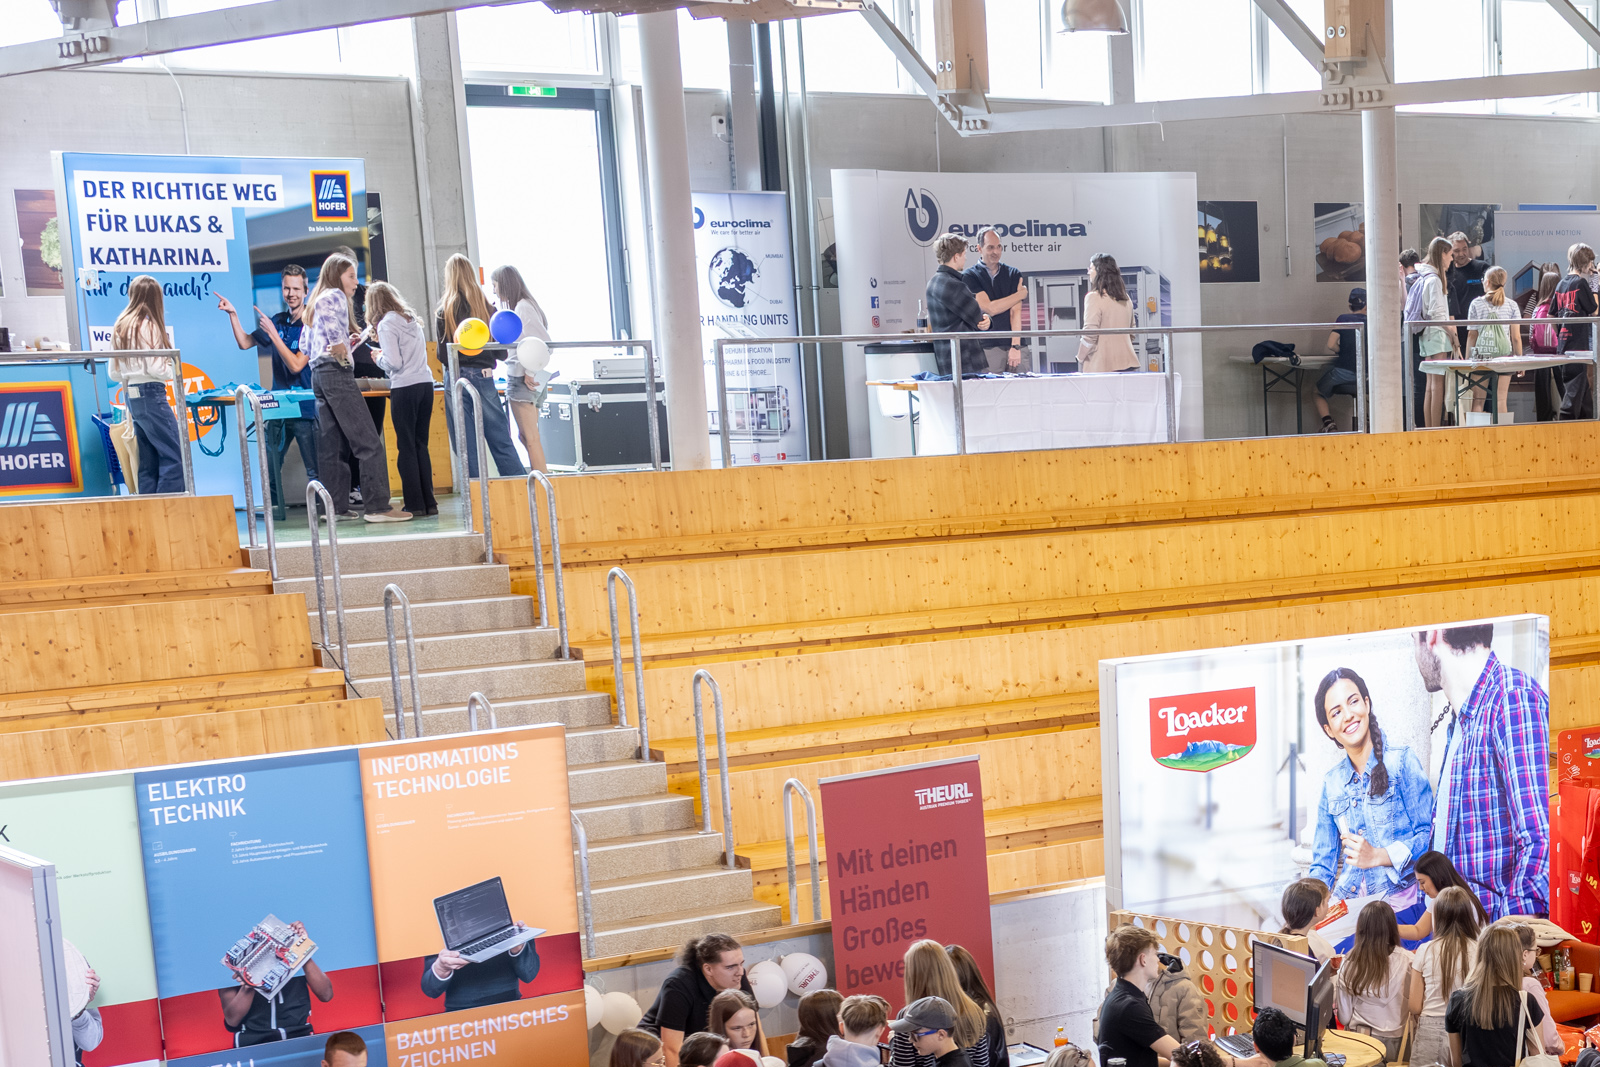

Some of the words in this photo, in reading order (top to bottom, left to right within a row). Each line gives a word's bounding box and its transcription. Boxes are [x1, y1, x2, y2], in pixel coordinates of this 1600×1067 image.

[83, 180, 125, 199] DER
[131, 181, 228, 201] RICHTIGE
[233, 183, 277, 201] WEG
[86, 208, 128, 233] FÜR
[135, 215, 201, 233] LUKAS
[208, 215, 223, 233] &
[318, 201, 347, 211] HOFER
[710, 219, 771, 228] euroclima
[89, 247, 222, 266] KATHARINA.
[1011, 242, 1044, 253] better
[1047, 242, 1062, 253] air
[760, 314, 788, 325] UNITS
[0, 453, 66, 470] HOFER
[1158, 702, 1248, 738] Loacker
[370, 742, 519, 776] INFORMATIONS
[146, 773, 247, 803] ELEKTRO
[372, 765, 511, 800] TECHNOLOGIE
[914, 782, 973, 805] THEURL
[150, 797, 247, 827] TECHNIK
[837, 849, 873, 878] Mit
[880, 838, 957, 870] deinen
[840, 879, 930, 915] Händen
[843, 917, 927, 951] Großes
[846, 960, 905, 989] bewe
[396, 1003, 569, 1051] BAUTECHNISCHES
